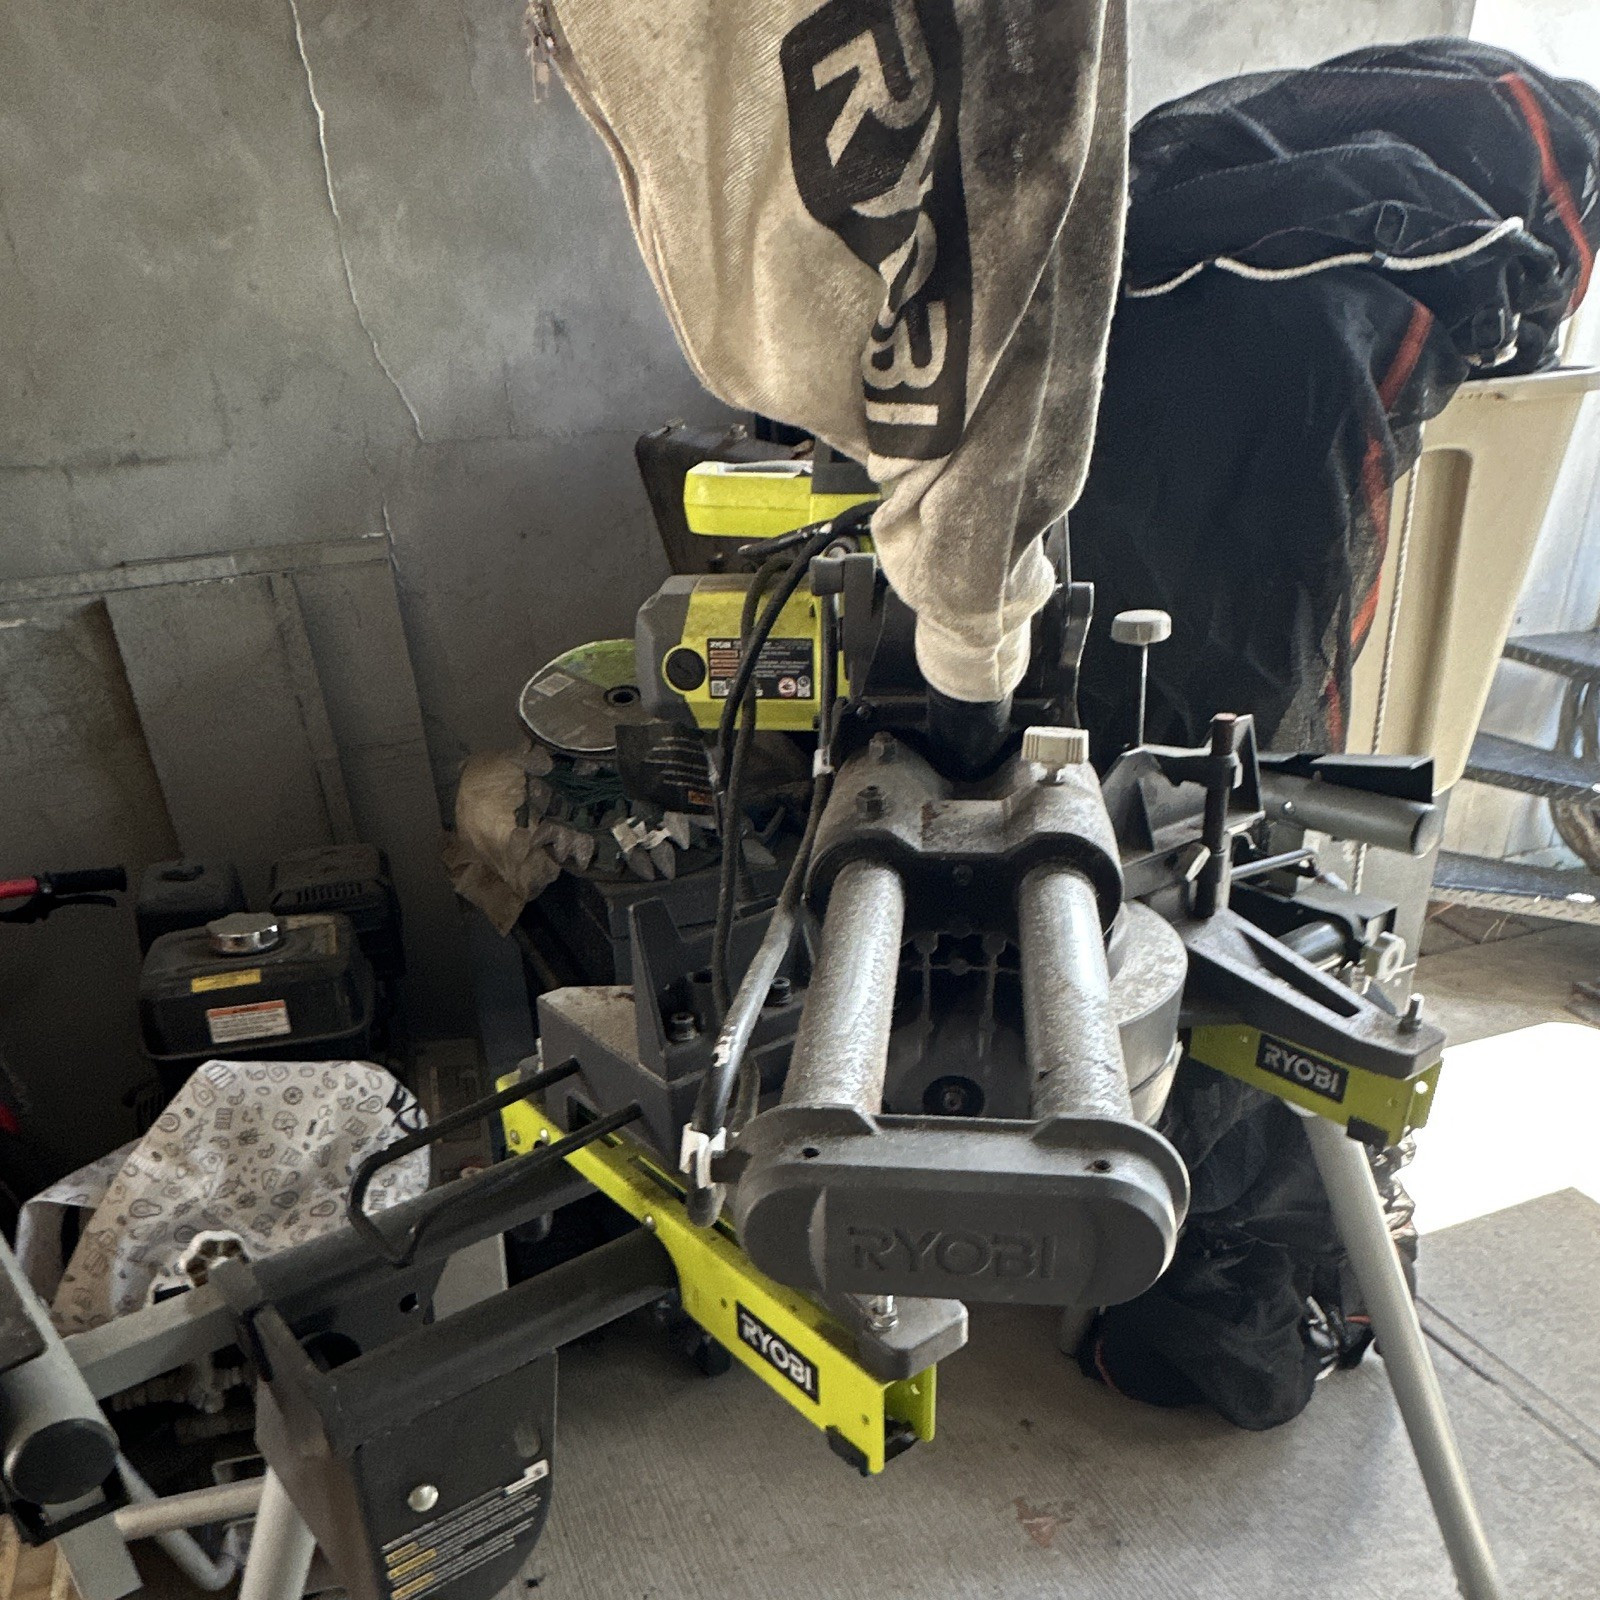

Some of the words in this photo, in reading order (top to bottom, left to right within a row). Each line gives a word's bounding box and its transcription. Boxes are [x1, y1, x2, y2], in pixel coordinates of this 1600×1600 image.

[1263, 1043, 1340, 1093] RYOBI
[848, 1226, 1058, 1280] RYOBI
[739, 1313, 812, 1391] RYOBI
